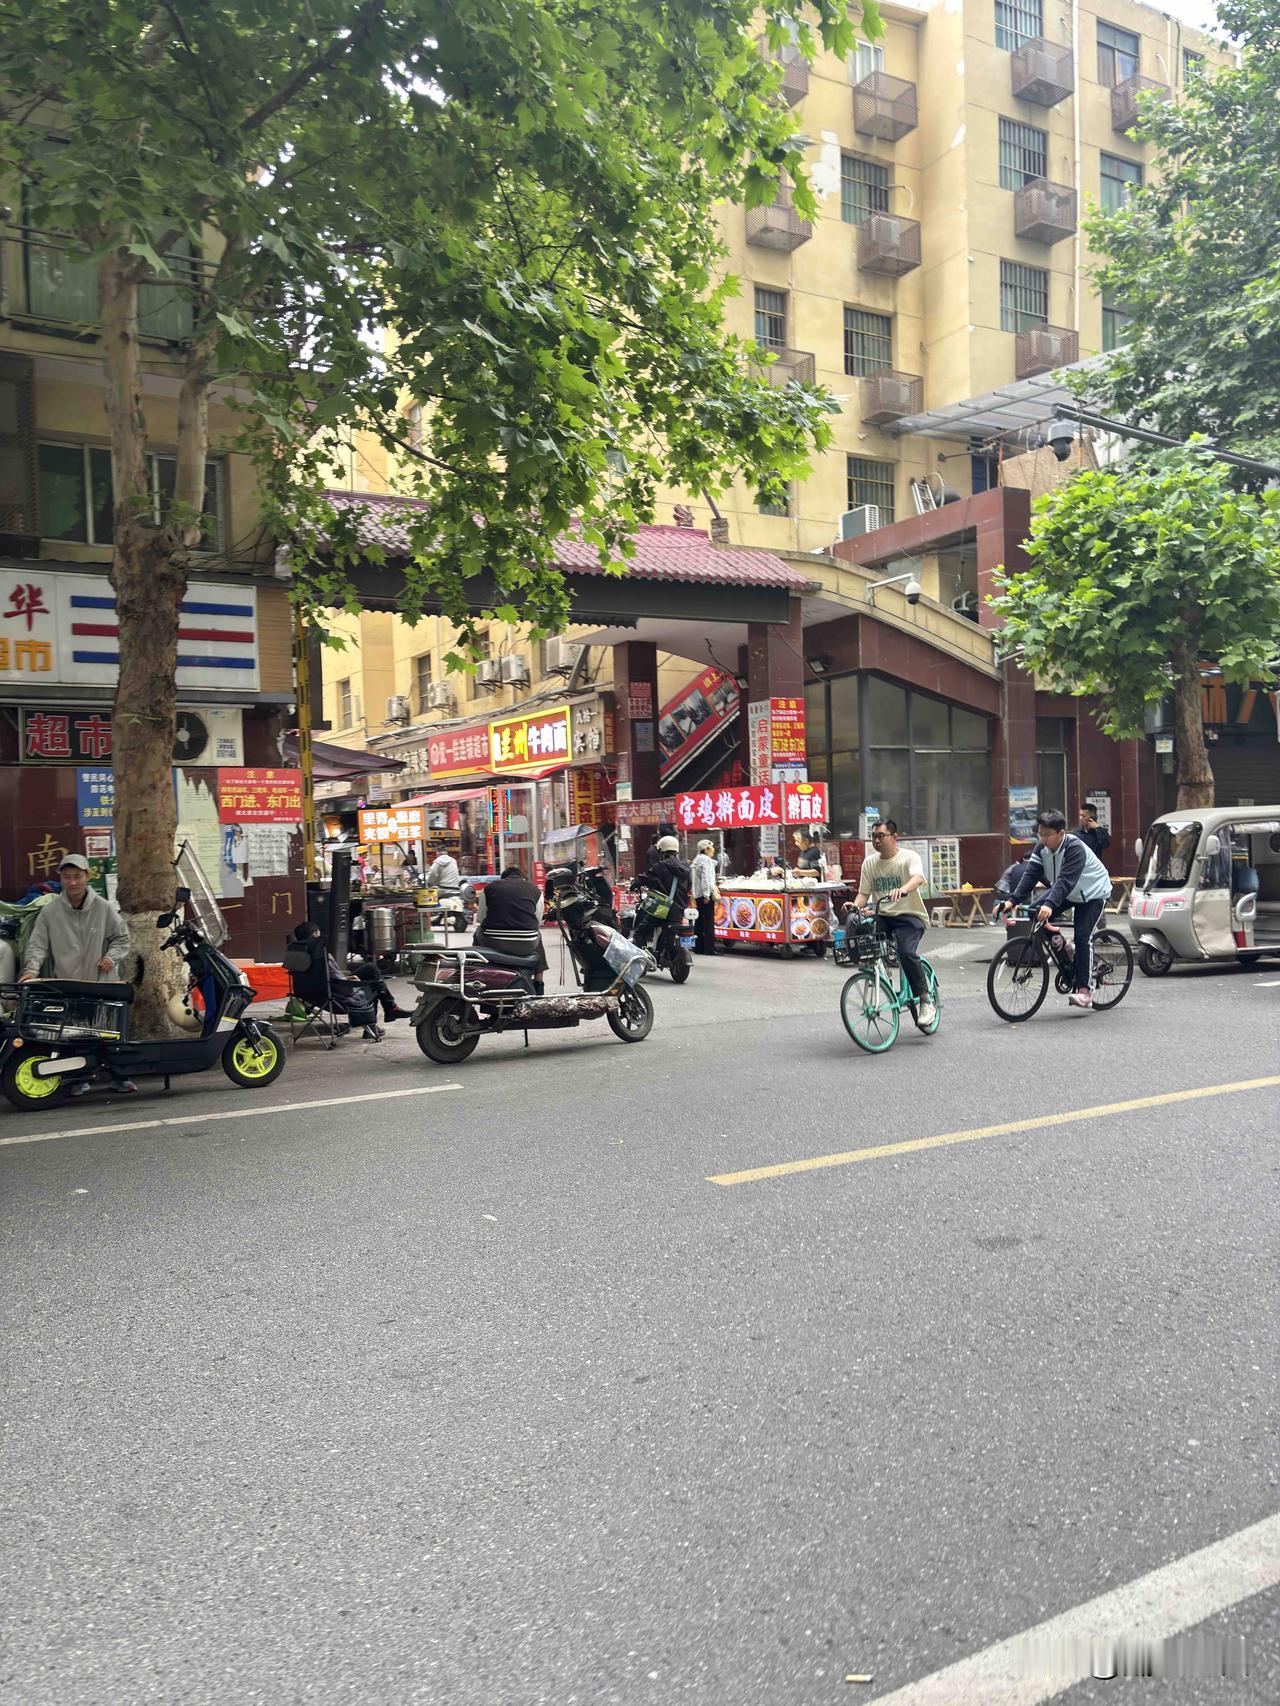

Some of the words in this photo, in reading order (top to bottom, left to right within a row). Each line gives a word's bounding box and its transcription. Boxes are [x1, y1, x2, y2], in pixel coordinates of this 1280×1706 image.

[3, 583, 50, 632] 华
[0, 637, 52, 672] 市
[26, 712, 112, 758] 超市
[500, 719, 567, 761] 兰州牛肉面
[220, 795, 301, 808] 西门进、东门出
[679, 788, 778, 826] 宝鸡擀面皮
[788, 793, 823, 820] 擀面皮
[397, 826, 422, 839] 豆浆
[27, 833, 69, 878] 南
